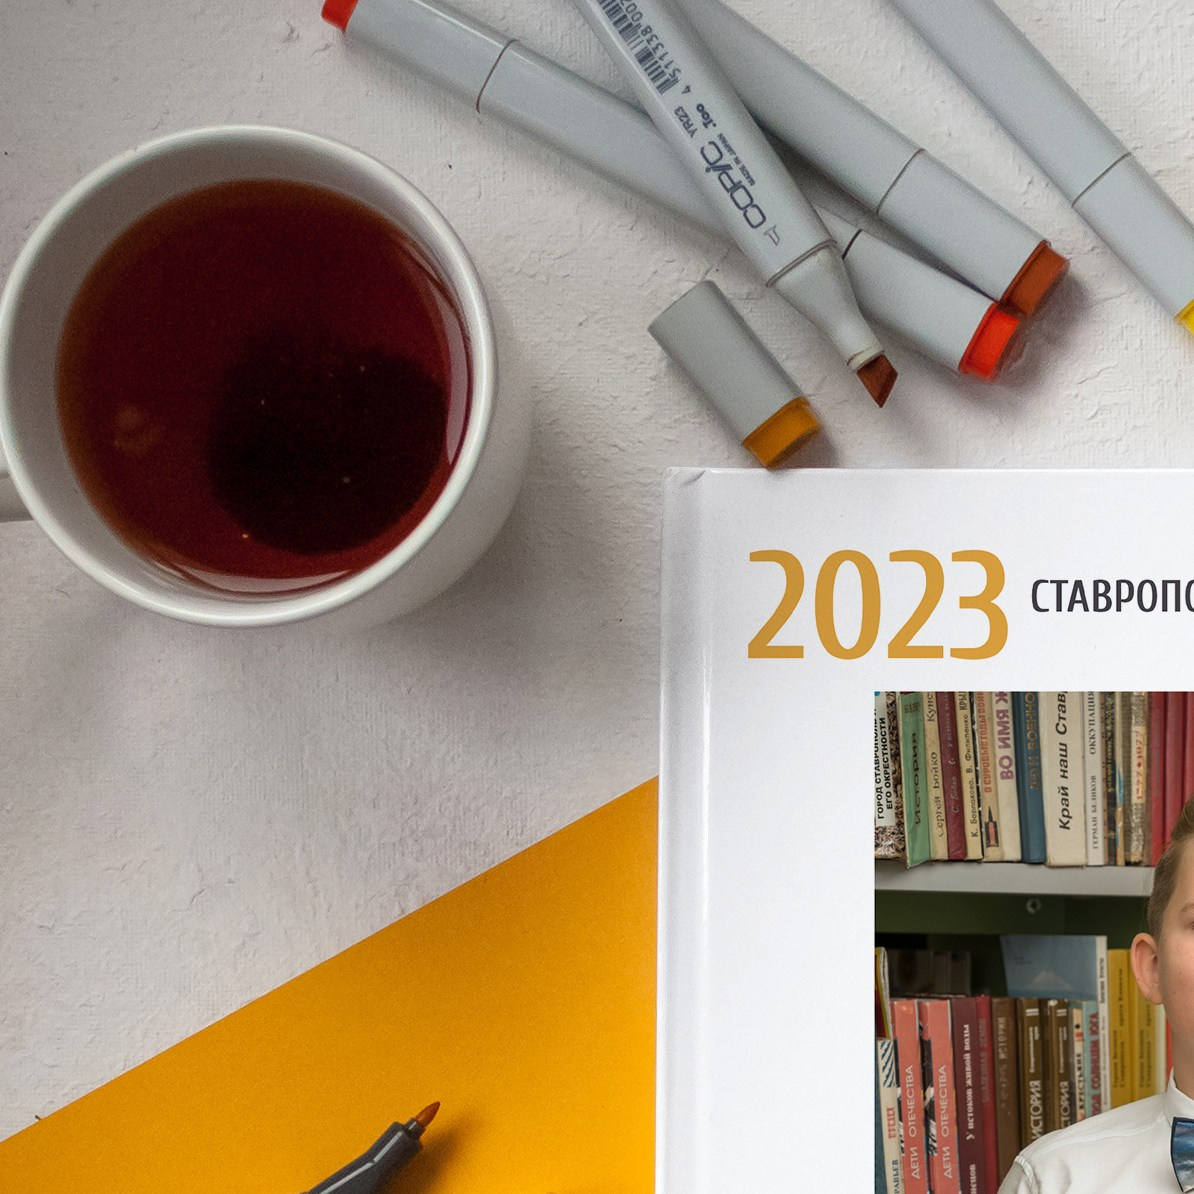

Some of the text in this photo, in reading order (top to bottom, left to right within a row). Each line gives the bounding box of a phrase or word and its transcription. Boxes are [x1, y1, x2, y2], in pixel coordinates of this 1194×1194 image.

[641, 25, 682, 79] 511338
[674, 106, 698, 138] YR23
[748, 550, 1008, 660] 2023
[963, 713, 972, 762] Филипенко
[978, 713, 988, 740] ГОДЫ
[995, 709, 1011, 749] ИМЯ
[1088, 692, 1097, 755] ОККУПАЦИЯ
[879, 717, 893, 810] ЕГО ОКРЕСТНОСТИ
[911, 732, 921, 825] История
[930, 751, 939, 790] Бойко
[981, 741, 991, 785] СУРОВЫЕ
[999, 755, 1014, 780] ВО
[1059, 743, 1069, 780] наш
[876, 786, 885, 819] ГОРОД
[1057, 786, 1073, 831] Край
[1089, 775, 1097, 813] БЕЛИКОВ
[933, 796, 944, 838] Сергей
[970, 828, 978, 838] К.
[962, 1024, 972, 1051] воды
[1089, 1011, 1099, 1036] ЮГА
[963, 1053, 973, 1087] живой
[1090, 1040, 1101, 1090] СОЛНЦЕМ
[905, 1065, 921, 1180] ДЕТИ ОТЕЧЕСТВА
[938, 1065, 953, 1180] ДЕТИ ОТЕЧЕСТВА
[965, 1088, 974, 1130] истоков
[1059, 1080, 1071, 1130] СТОРИЯ
[966, 1131, 975, 1140] У
